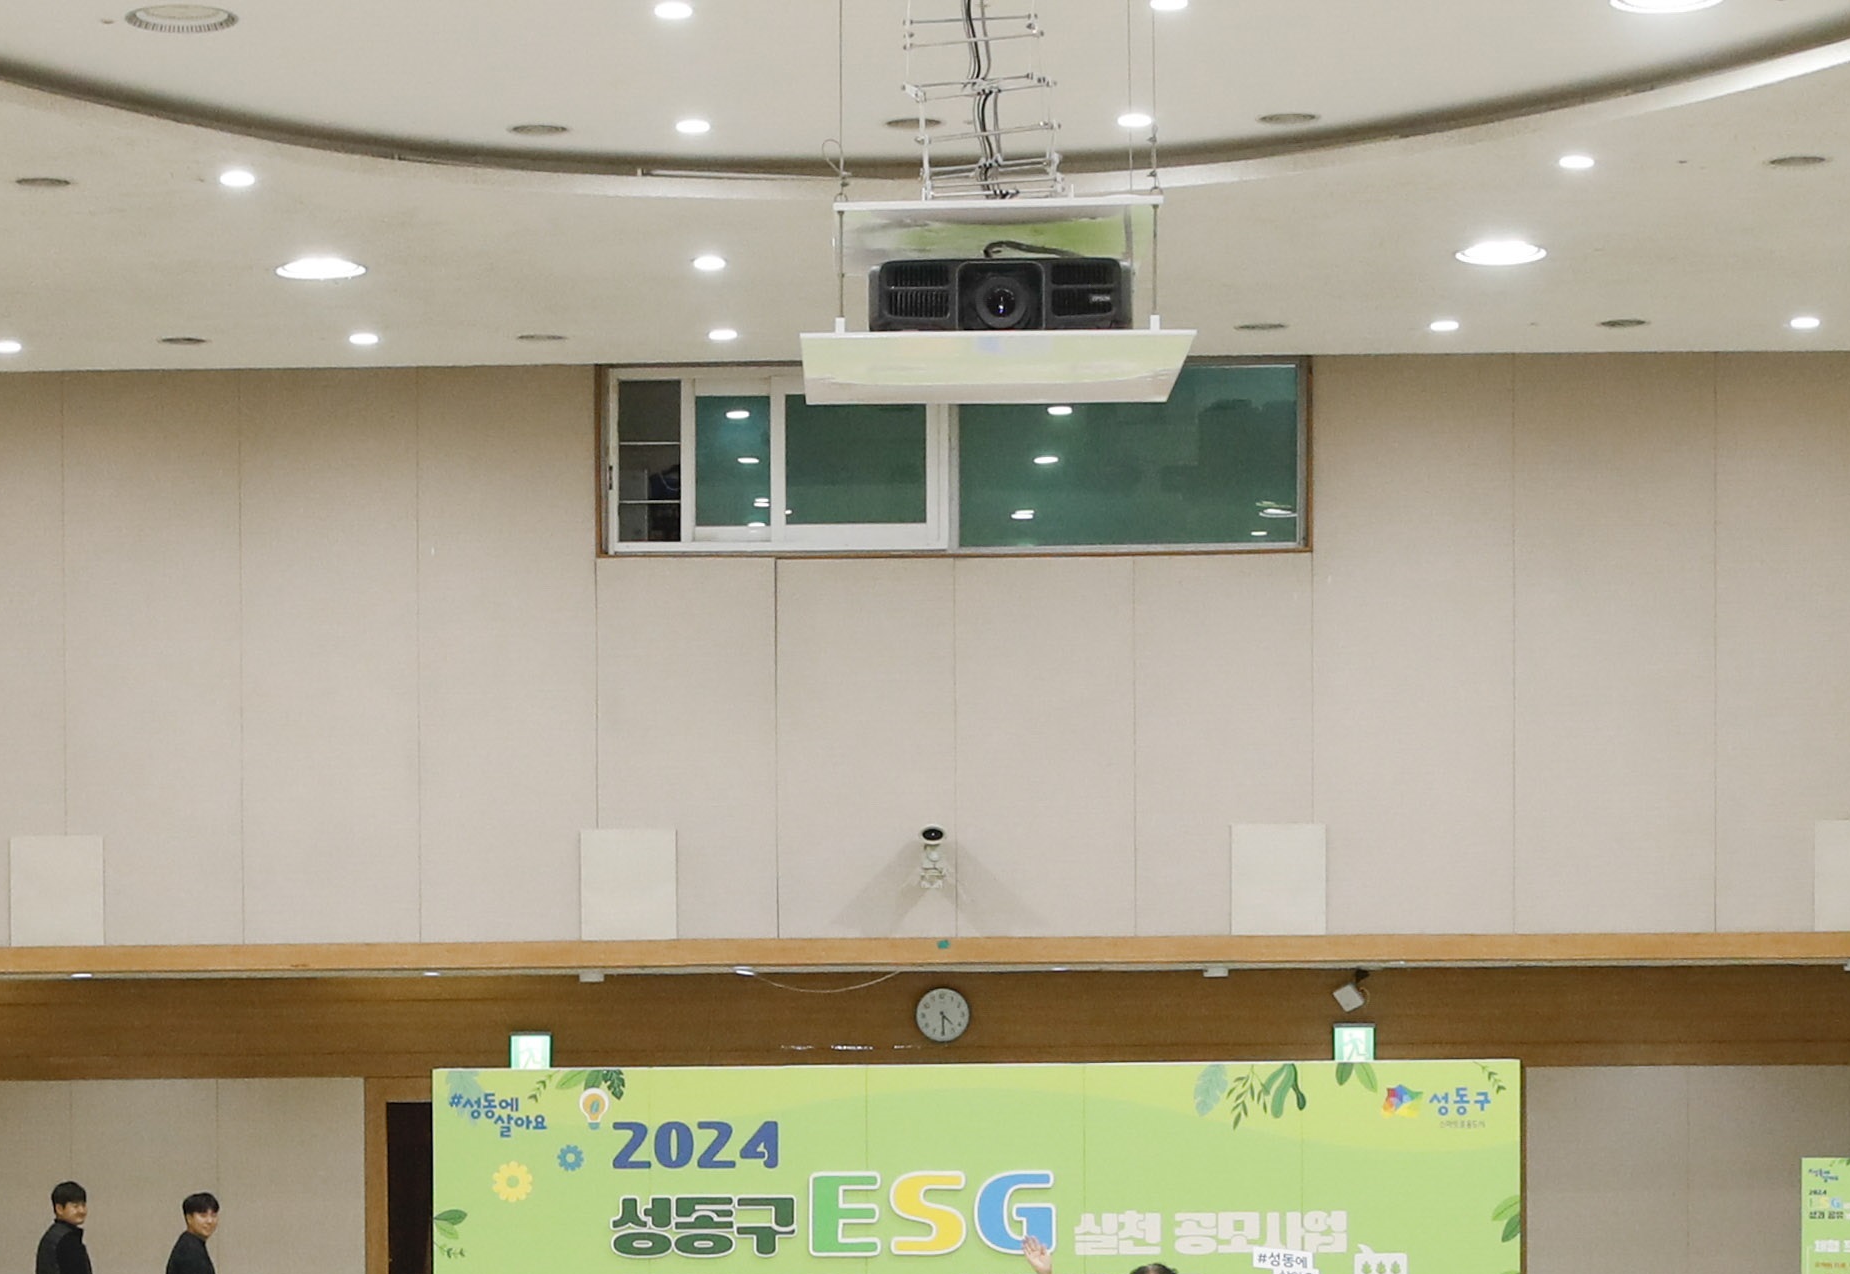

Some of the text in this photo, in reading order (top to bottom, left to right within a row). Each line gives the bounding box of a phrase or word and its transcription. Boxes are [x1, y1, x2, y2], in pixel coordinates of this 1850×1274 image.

[448, 1092, 519, 1120] #성동에
[1429, 1087, 1492, 1116] 성동구
[494, 1114, 547, 1137] 살아요
[611, 1120, 780, 1169] 2024
[610, 1170, 1348, 1258] 성동구 ESG 실천 공모사업
[1257, 1251, 1308, 1270] #성동에
